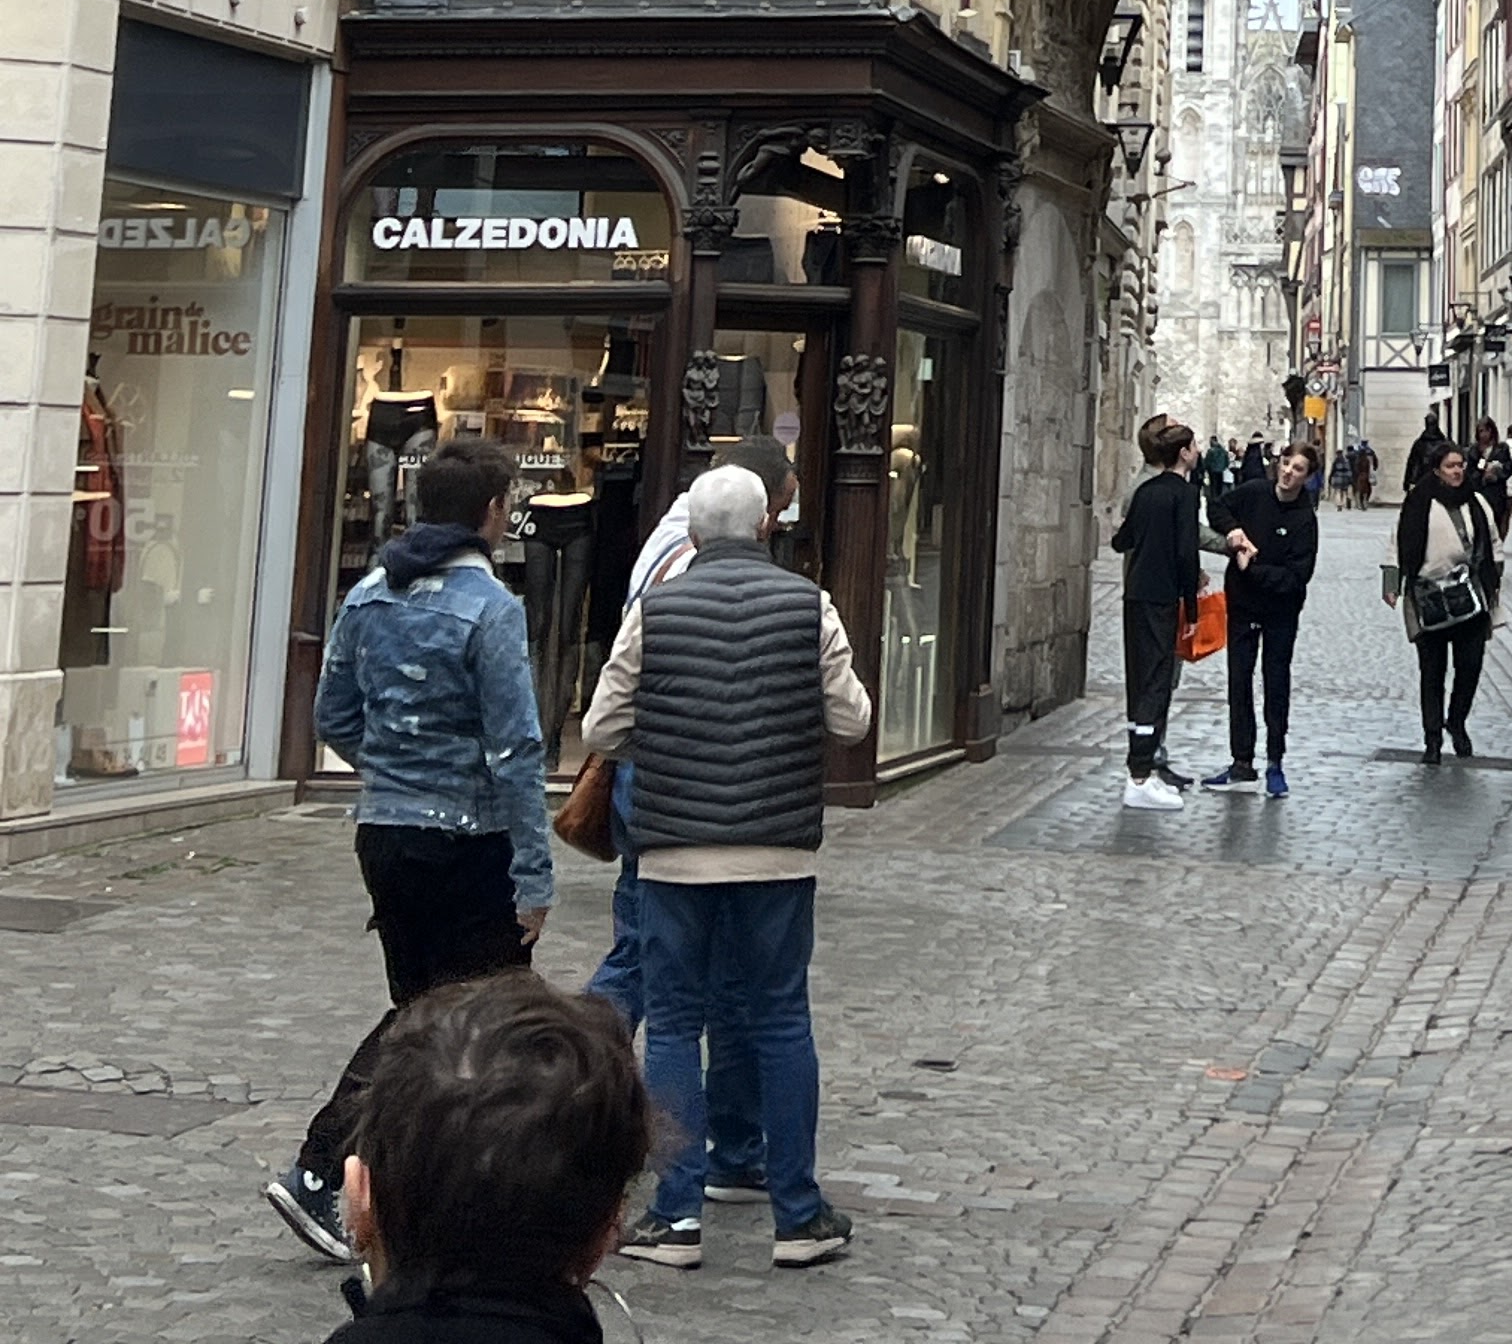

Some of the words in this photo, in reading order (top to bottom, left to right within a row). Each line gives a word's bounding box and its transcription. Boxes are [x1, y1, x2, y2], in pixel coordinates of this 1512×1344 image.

[372, 216, 639, 250] CALZEDONIA
[91, 296, 183, 340] grain
[126, 319, 252, 356] malice
